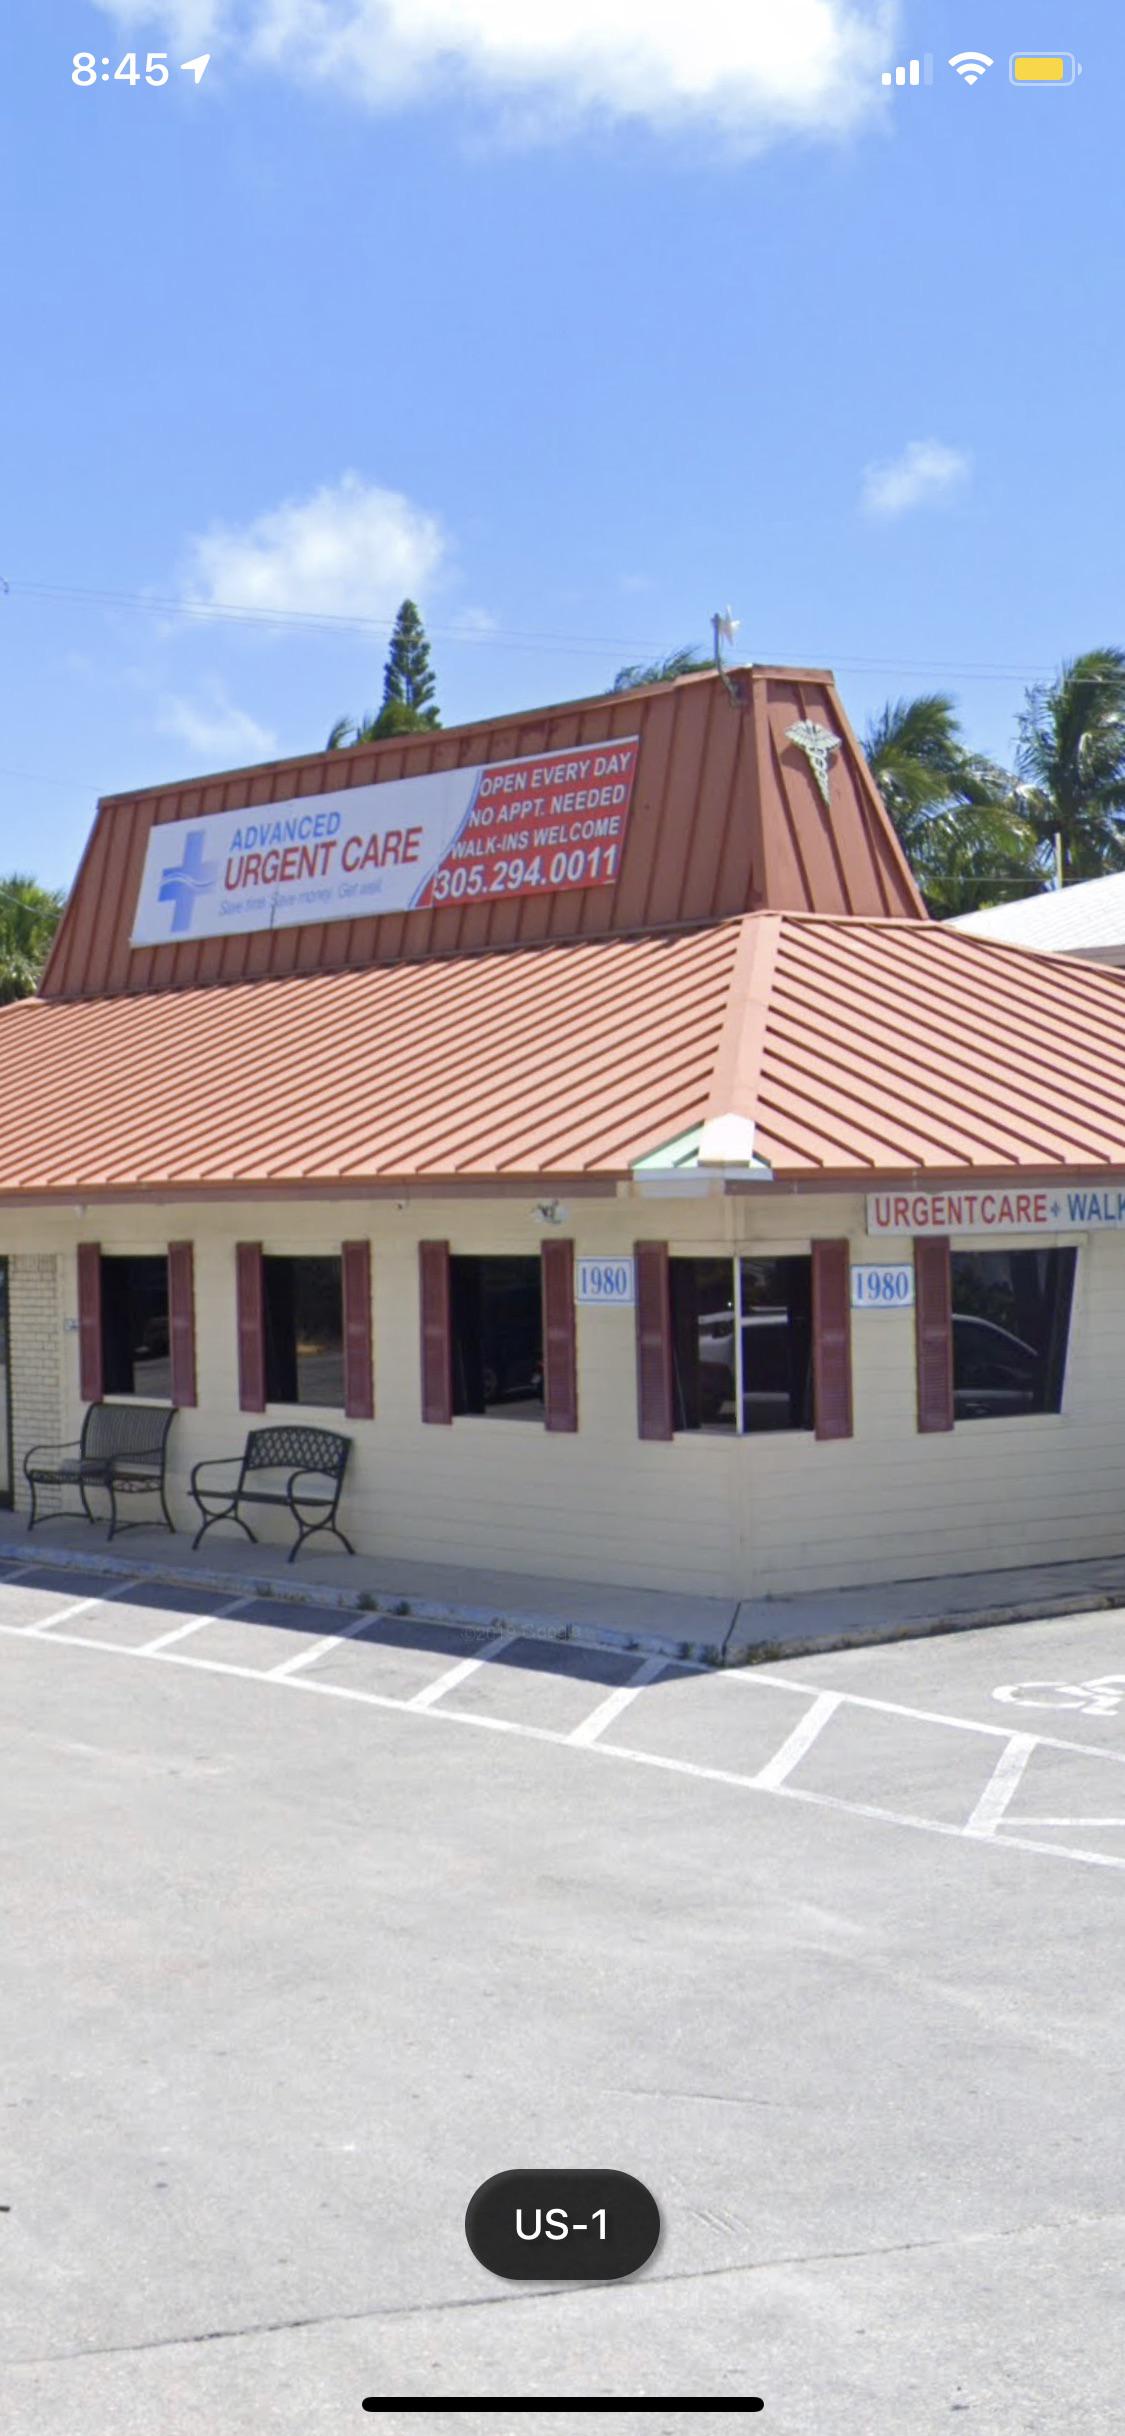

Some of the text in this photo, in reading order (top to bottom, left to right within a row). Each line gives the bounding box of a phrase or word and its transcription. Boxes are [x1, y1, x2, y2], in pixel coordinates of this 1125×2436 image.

[480, 752, 631, 797] OPEN EVERY DAY
[468, 783, 625, 828] NO APPT. NEEDED
[229, 811, 341, 851] ADVANCED
[450, 815, 621, 860] WALK-INS WELCOME
[224, 826, 423, 891] URGENT CARE
[433, 843, 617, 900] 305.294.0011
[580, 1268, 628, 1296] 1980
[855, 1272, 910, 1301] 1980
